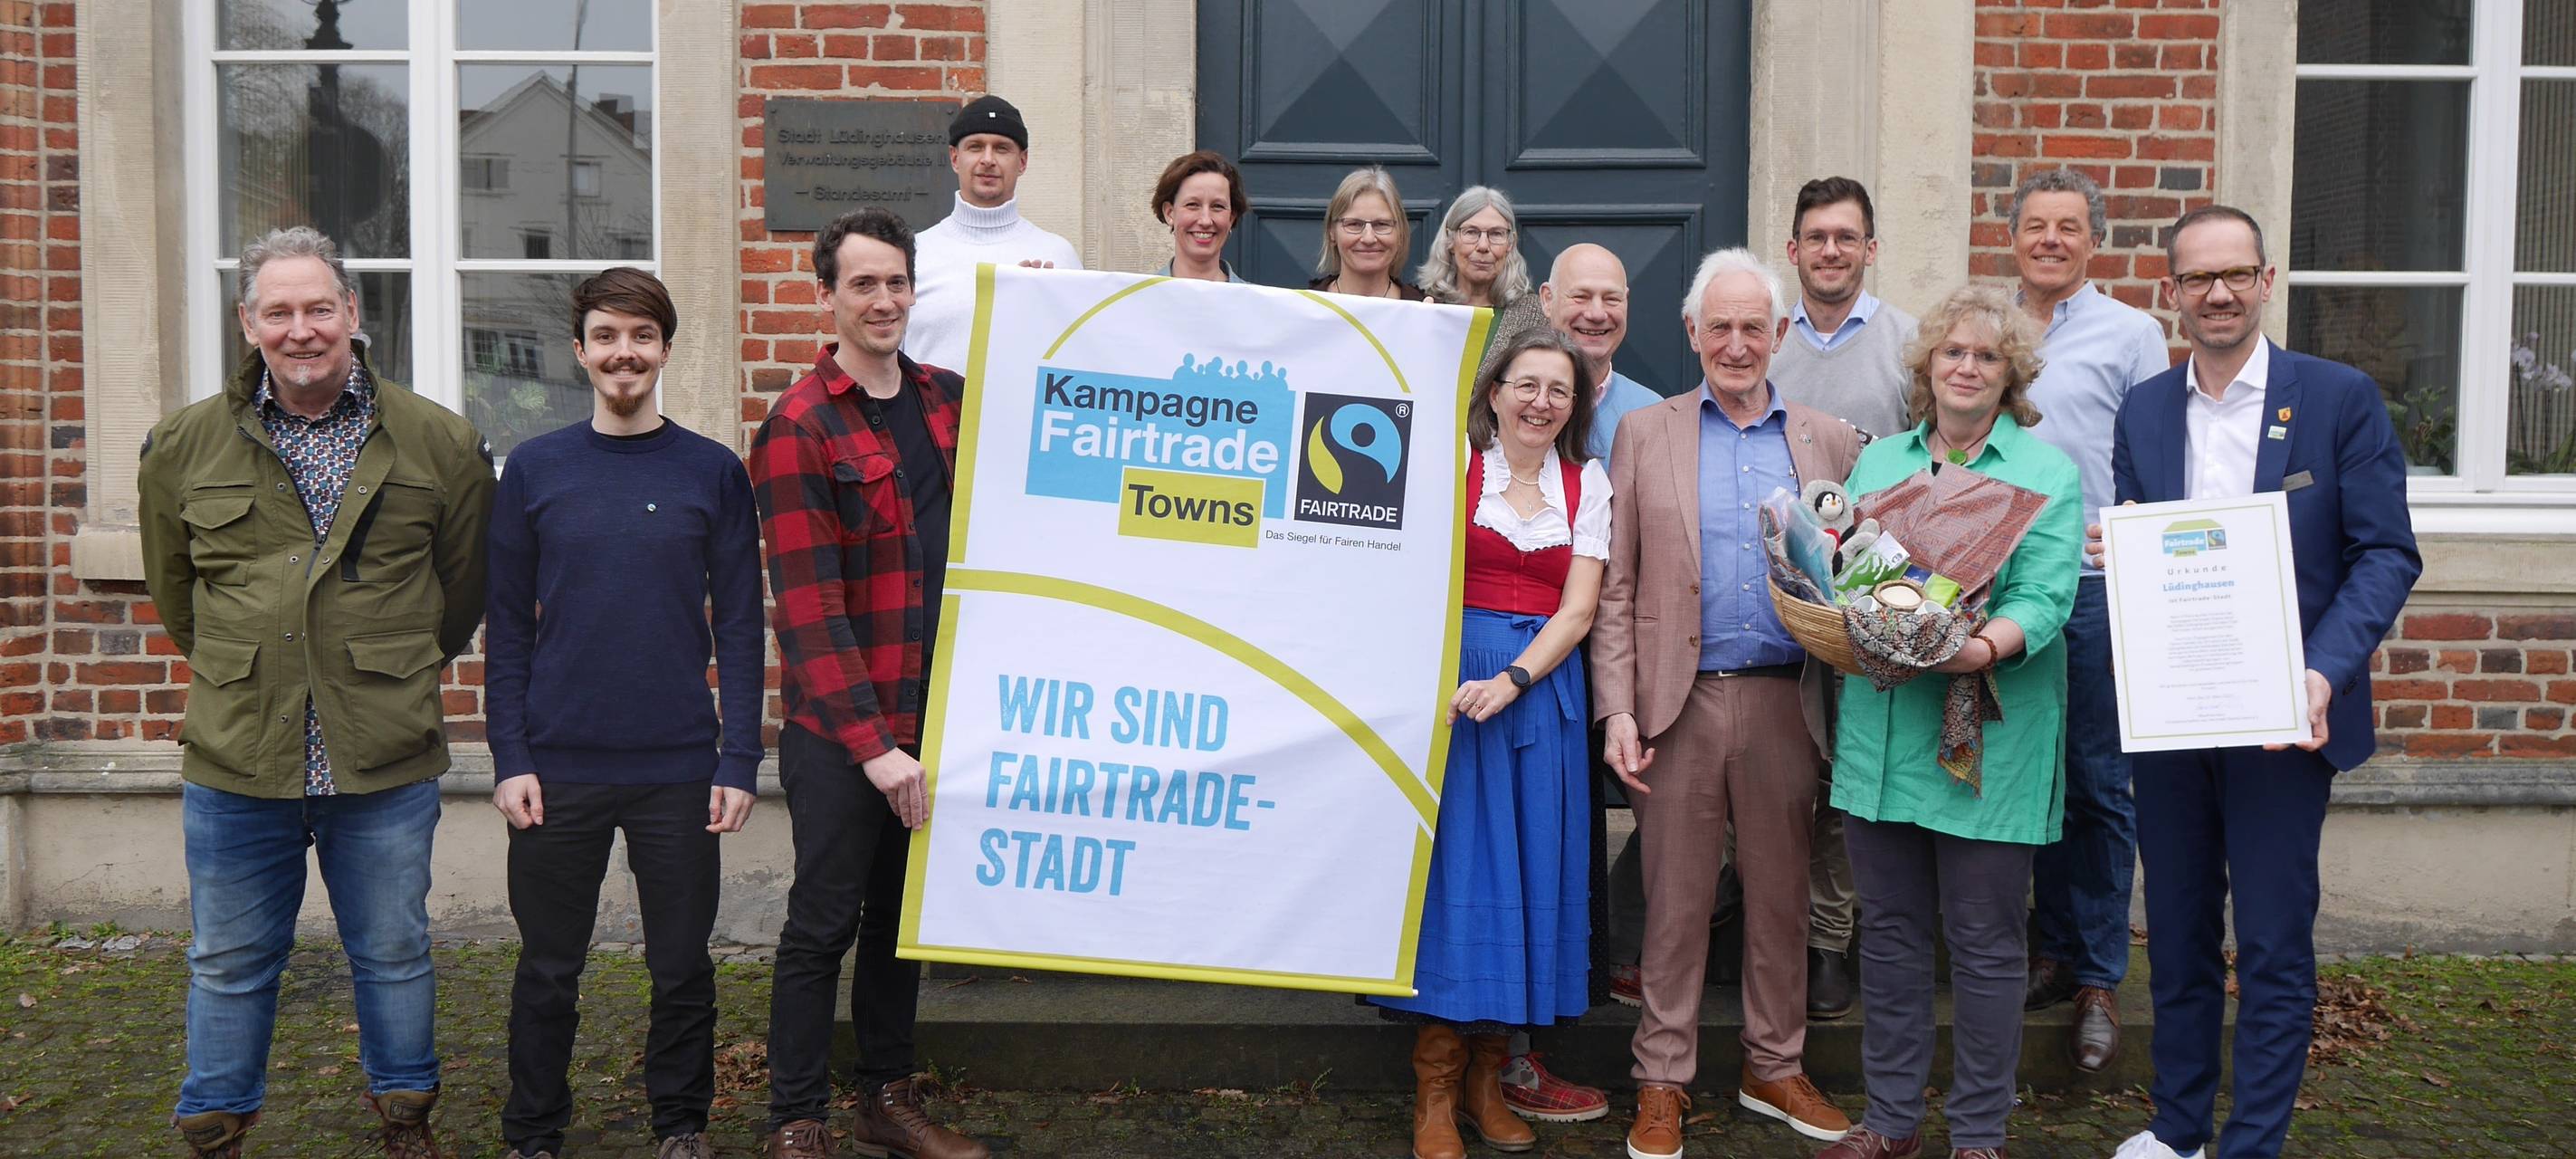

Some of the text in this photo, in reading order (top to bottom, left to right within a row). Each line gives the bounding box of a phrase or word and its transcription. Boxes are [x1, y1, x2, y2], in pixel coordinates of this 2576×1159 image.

[778, 129, 948, 148] Stadt Lüdinghausen
[781, 152, 932, 169] Verwaltungsgebäude
[814, 187, 912, 201] Standesamt
[1044, 373, 1258, 426] Kampagne
[1039, 409, 1279, 474] Fairtrade
[1128, 484, 1255, 527] Towns
[1300, 499, 1398, 522] FAIRTRADE
[1265, 530, 1401, 551] Das Siegel für Fairen Handel
[2163, 536, 2206, 548] Fairtrade
[2167, 565, 2227, 576] Urkunde
[2162, 580, 2235, 592] Lüdinghausen
[998, 675, 1228, 752] WIR SIND
[986, 751, 1275, 831] FAIRTRADE-
[976, 828, 1136, 896] STADT
